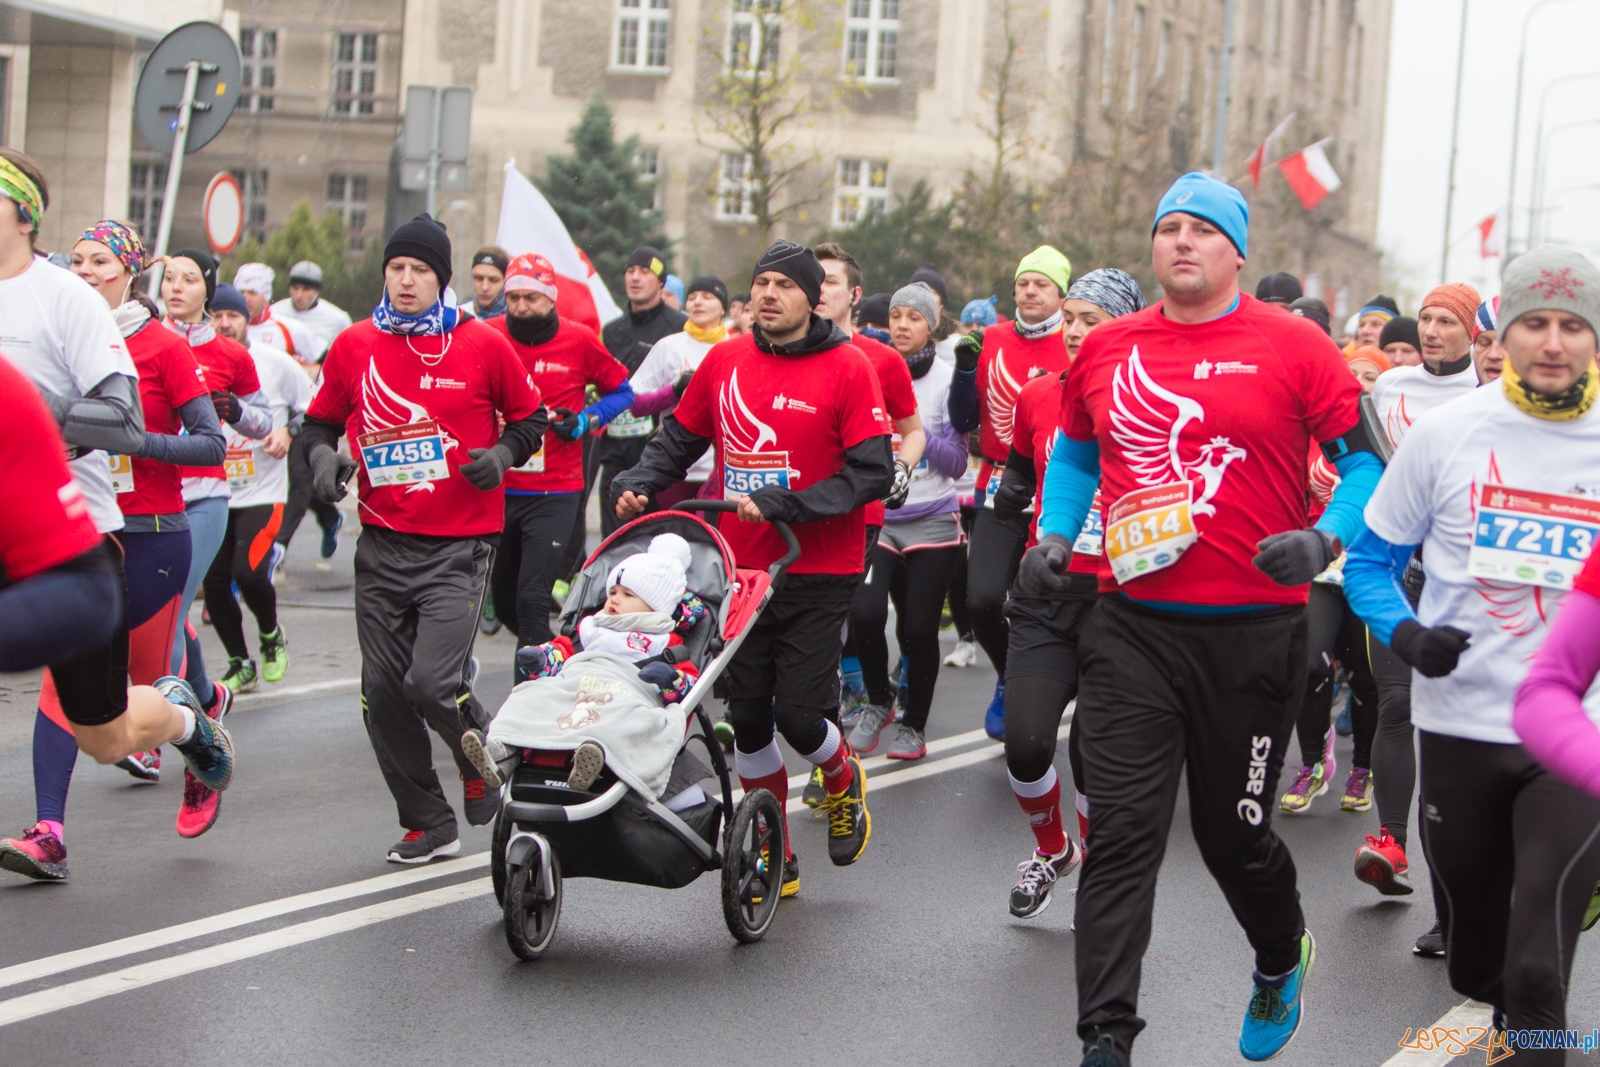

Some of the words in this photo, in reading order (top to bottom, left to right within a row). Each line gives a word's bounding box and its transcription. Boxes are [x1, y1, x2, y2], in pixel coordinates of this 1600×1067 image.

[373, 440, 436, 466] 7458
[727, 470, 780, 491] 2565
[1141, 492, 1184, 505] RunPoland.org
[1115, 509, 1181, 551] 1814
[1494, 516, 1592, 560] 7213
[579, 675, 634, 697] Blanka
[1245, 735, 1272, 796] asics
